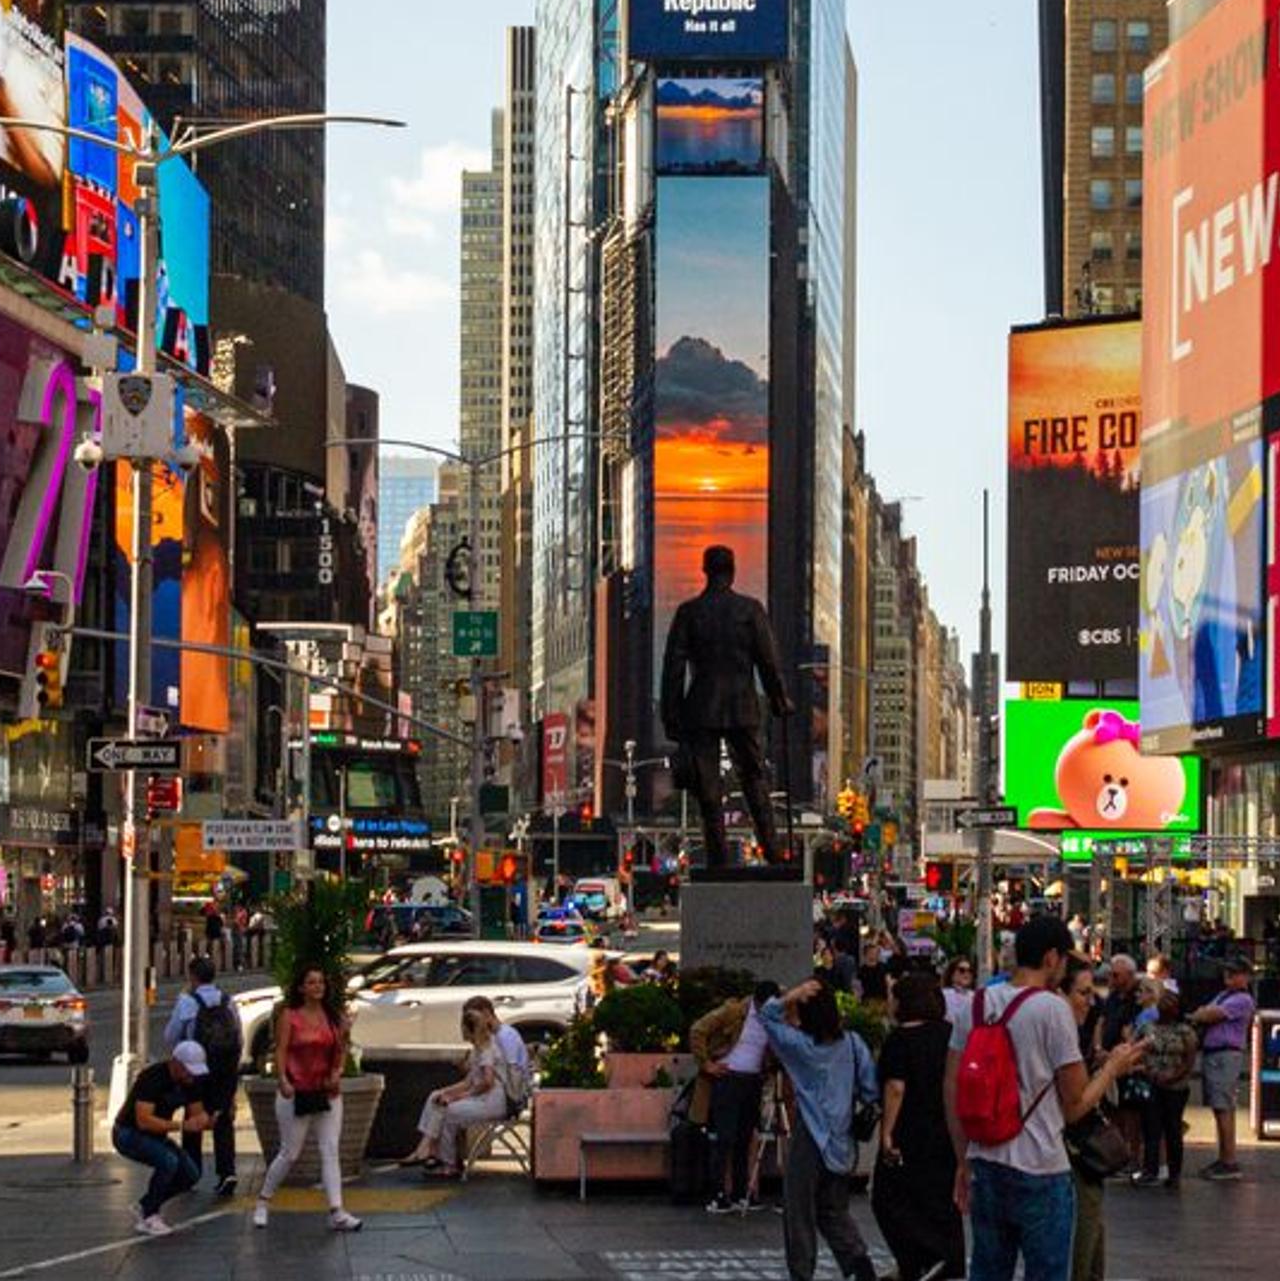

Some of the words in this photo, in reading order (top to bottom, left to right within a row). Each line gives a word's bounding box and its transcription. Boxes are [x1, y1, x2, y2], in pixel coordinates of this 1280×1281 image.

[1023, 415, 1088, 456] FIRE
[319, 518, 333, 584] 1500
[1047, 565, 1110, 584] FRIDAY
[1090, 628, 1122, 644] CBS
